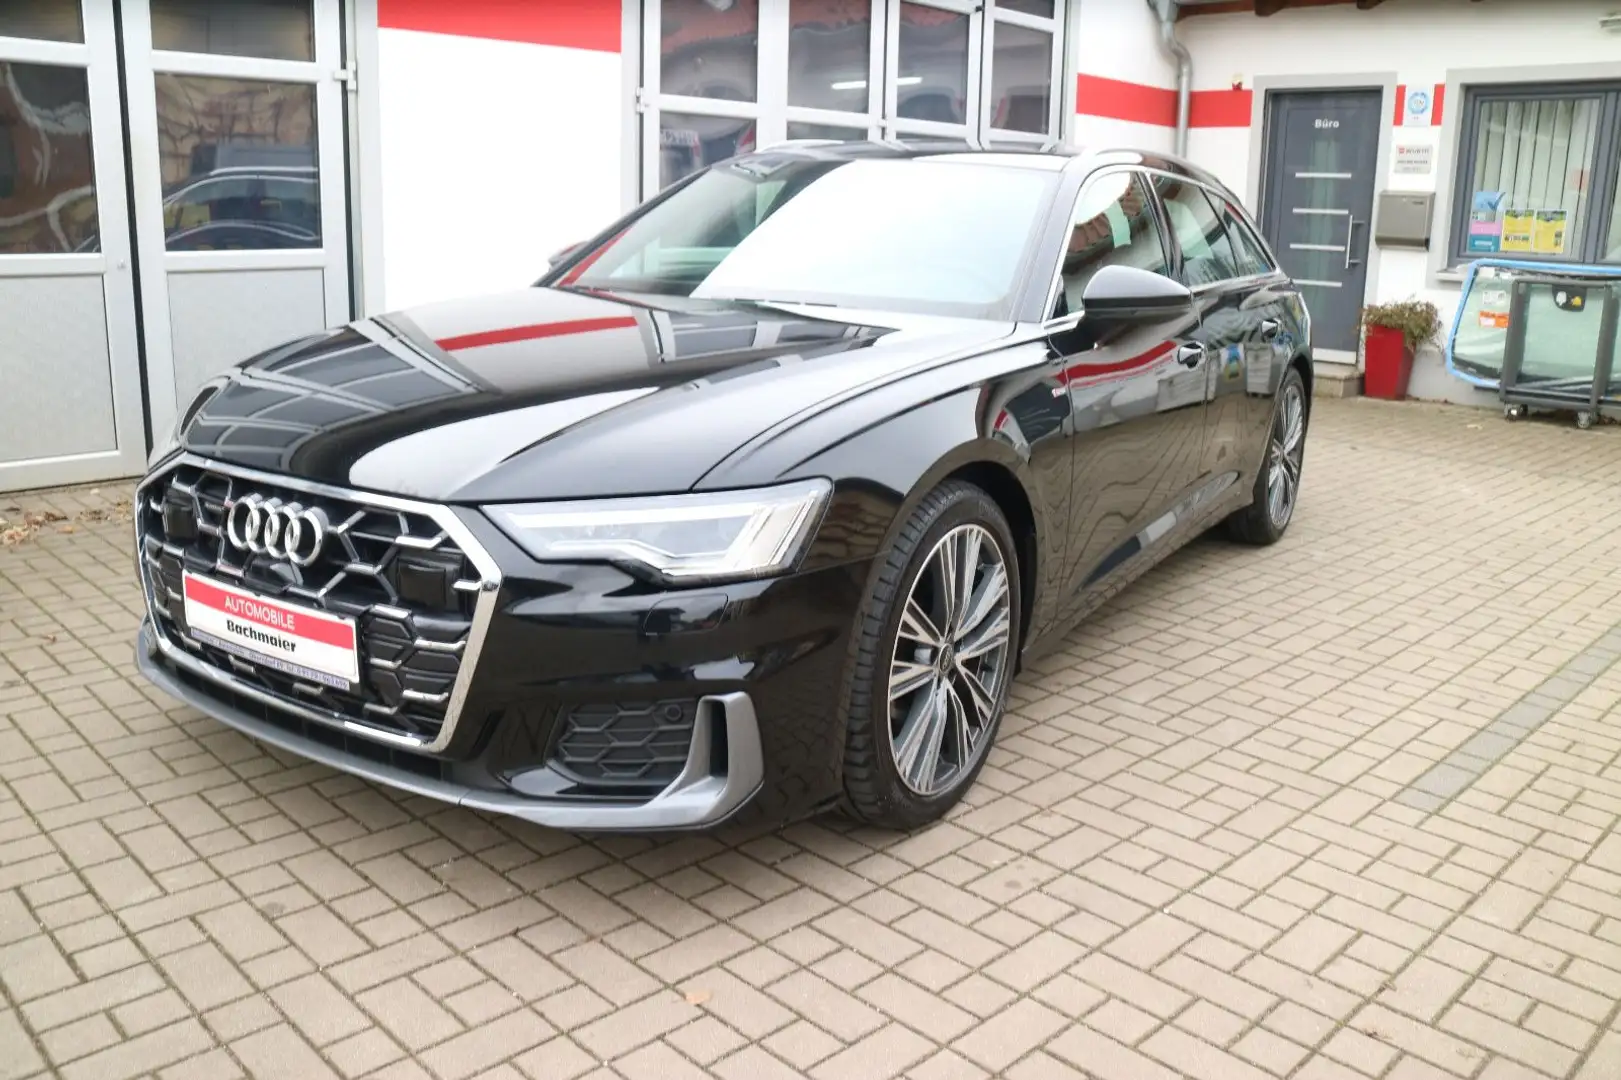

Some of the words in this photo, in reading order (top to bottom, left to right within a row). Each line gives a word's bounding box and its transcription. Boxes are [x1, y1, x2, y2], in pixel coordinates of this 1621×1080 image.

[1314, 118, 1340, 128] Büro
[225, 596, 295, 631] AUTOMOBILE
[227, 620, 296, 652] Bachmaier
